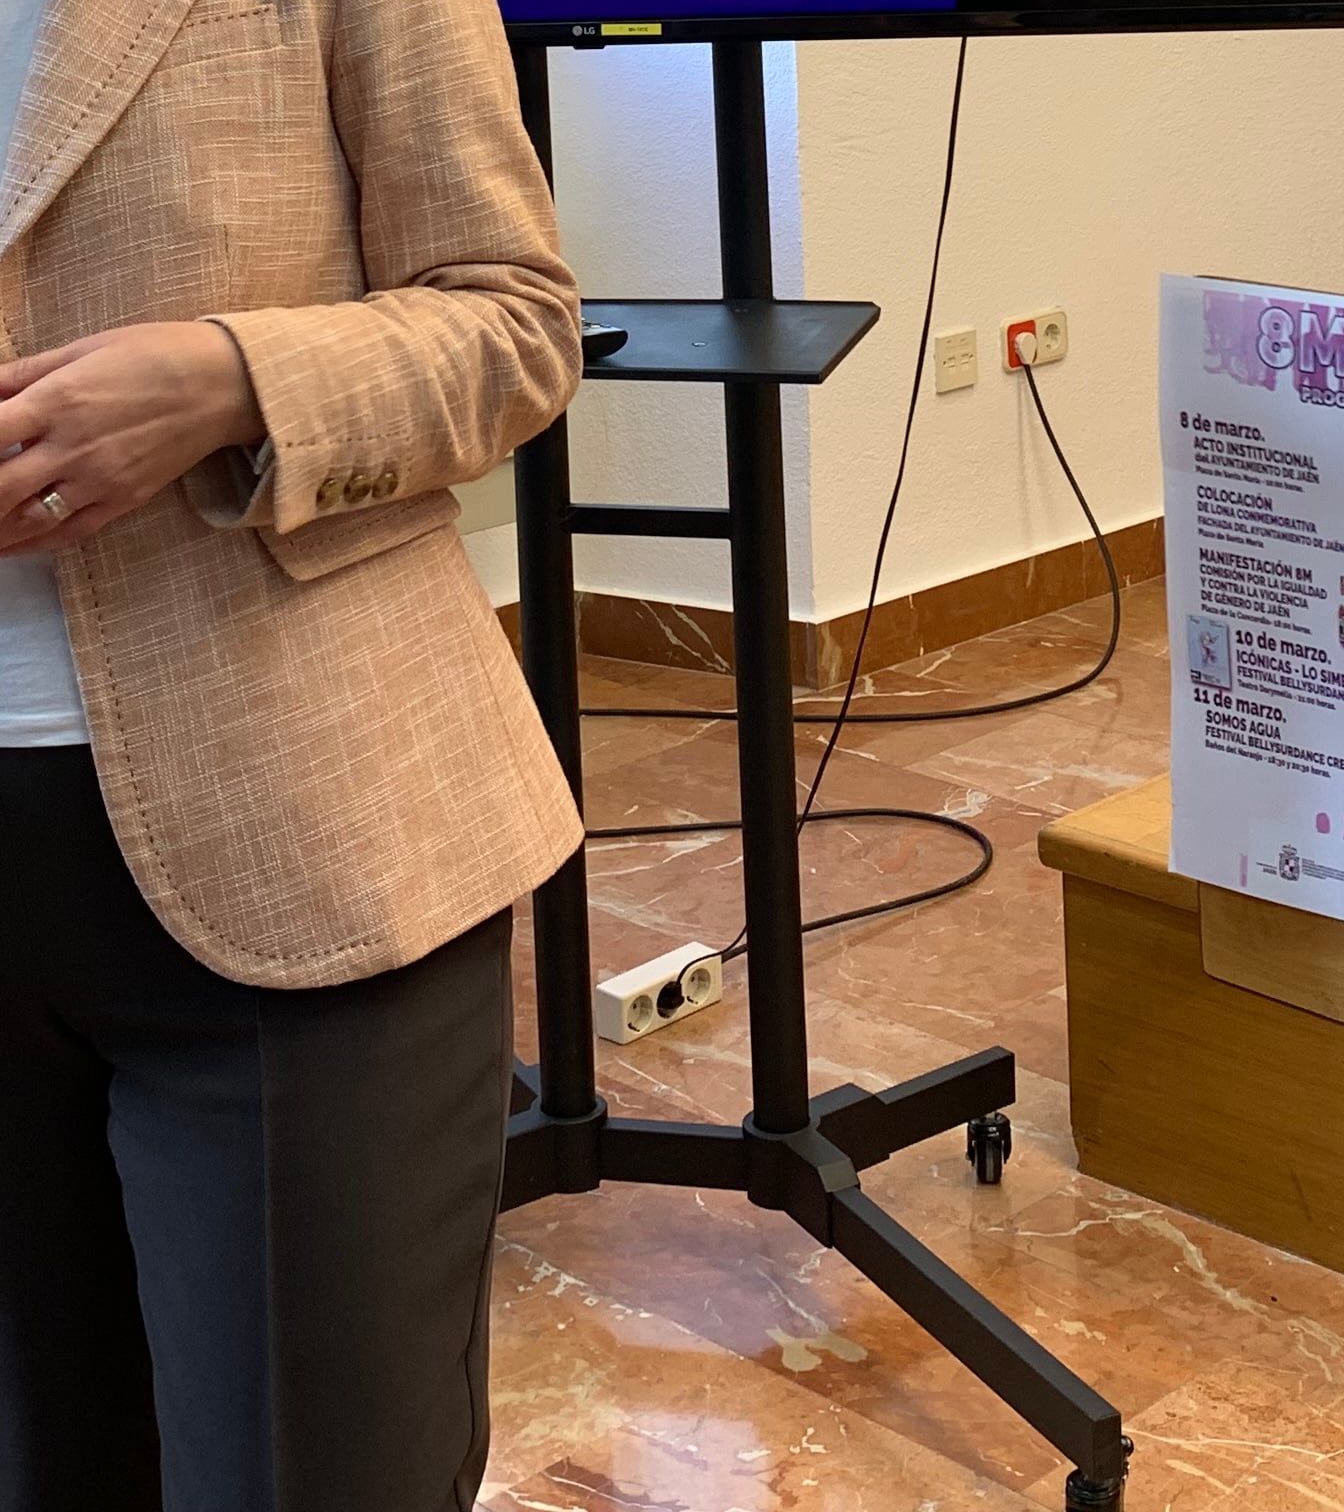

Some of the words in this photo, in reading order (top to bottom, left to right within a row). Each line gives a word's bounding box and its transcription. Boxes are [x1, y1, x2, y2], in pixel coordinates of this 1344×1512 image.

[1180, 411, 1189, 429] 8
[1192, 413, 1212, 433] de
[1214, 420, 1265, 442] marzo.
[1235, 629, 1253, 646] 10
[1257, 631, 1277, 652] de
[1280, 640, 1332, 665] marzo.
[1194, 687, 1210, 705] 11
[1213, 690, 1233, 710] de
[1236, 698, 1287, 723] marzo.
